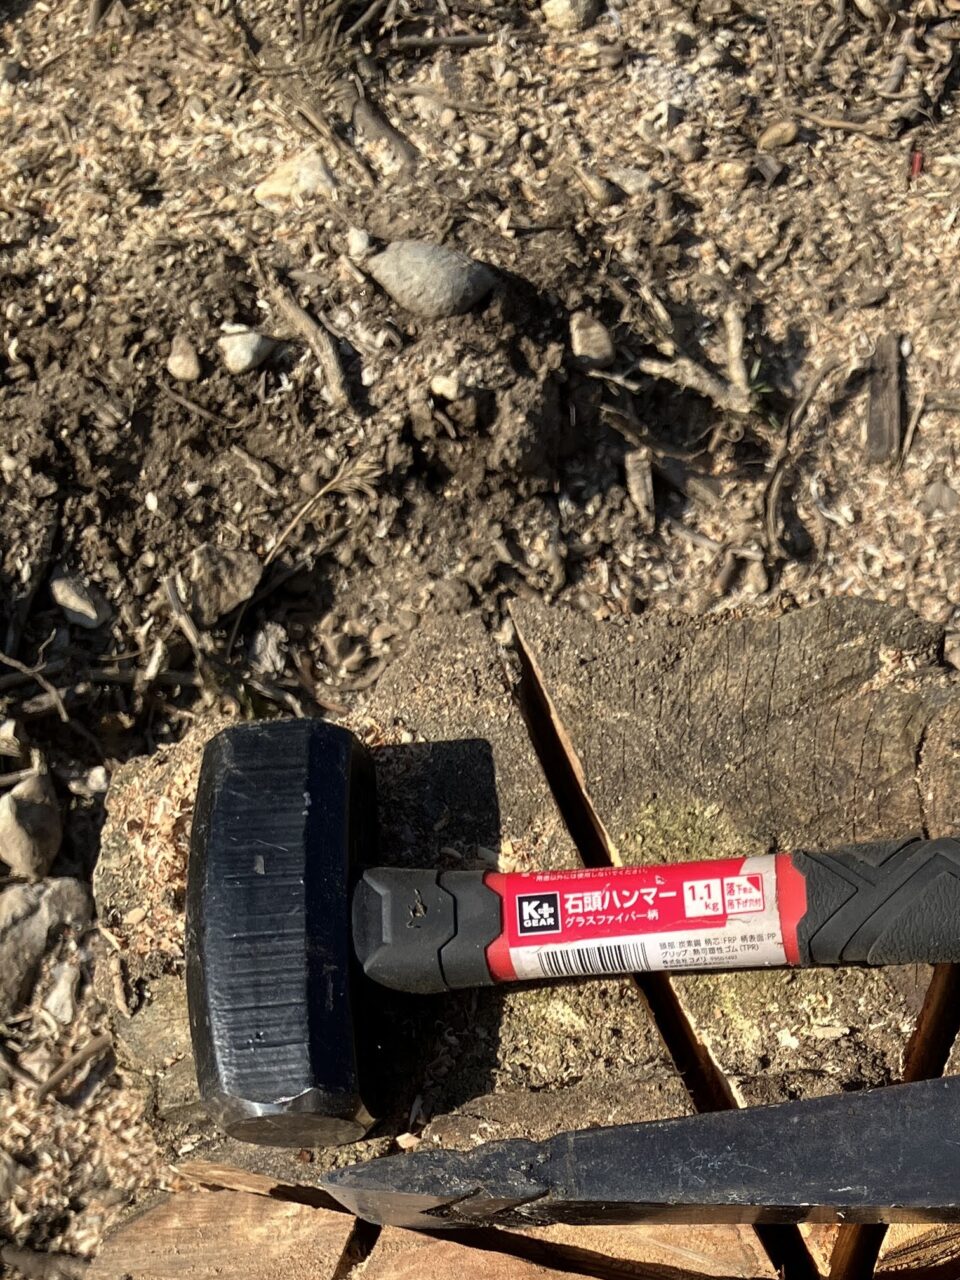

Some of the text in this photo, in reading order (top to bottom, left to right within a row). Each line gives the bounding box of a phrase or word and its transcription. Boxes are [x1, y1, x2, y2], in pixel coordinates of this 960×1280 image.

[564, 887, 677, 914] 石頭ハンマー
[688, 883, 712, 901] 1.1
[704, 901, 719, 912] kg
[523, 918, 555, 928] GEAR
[565, 909, 659, 928] グラスファイバー柄
